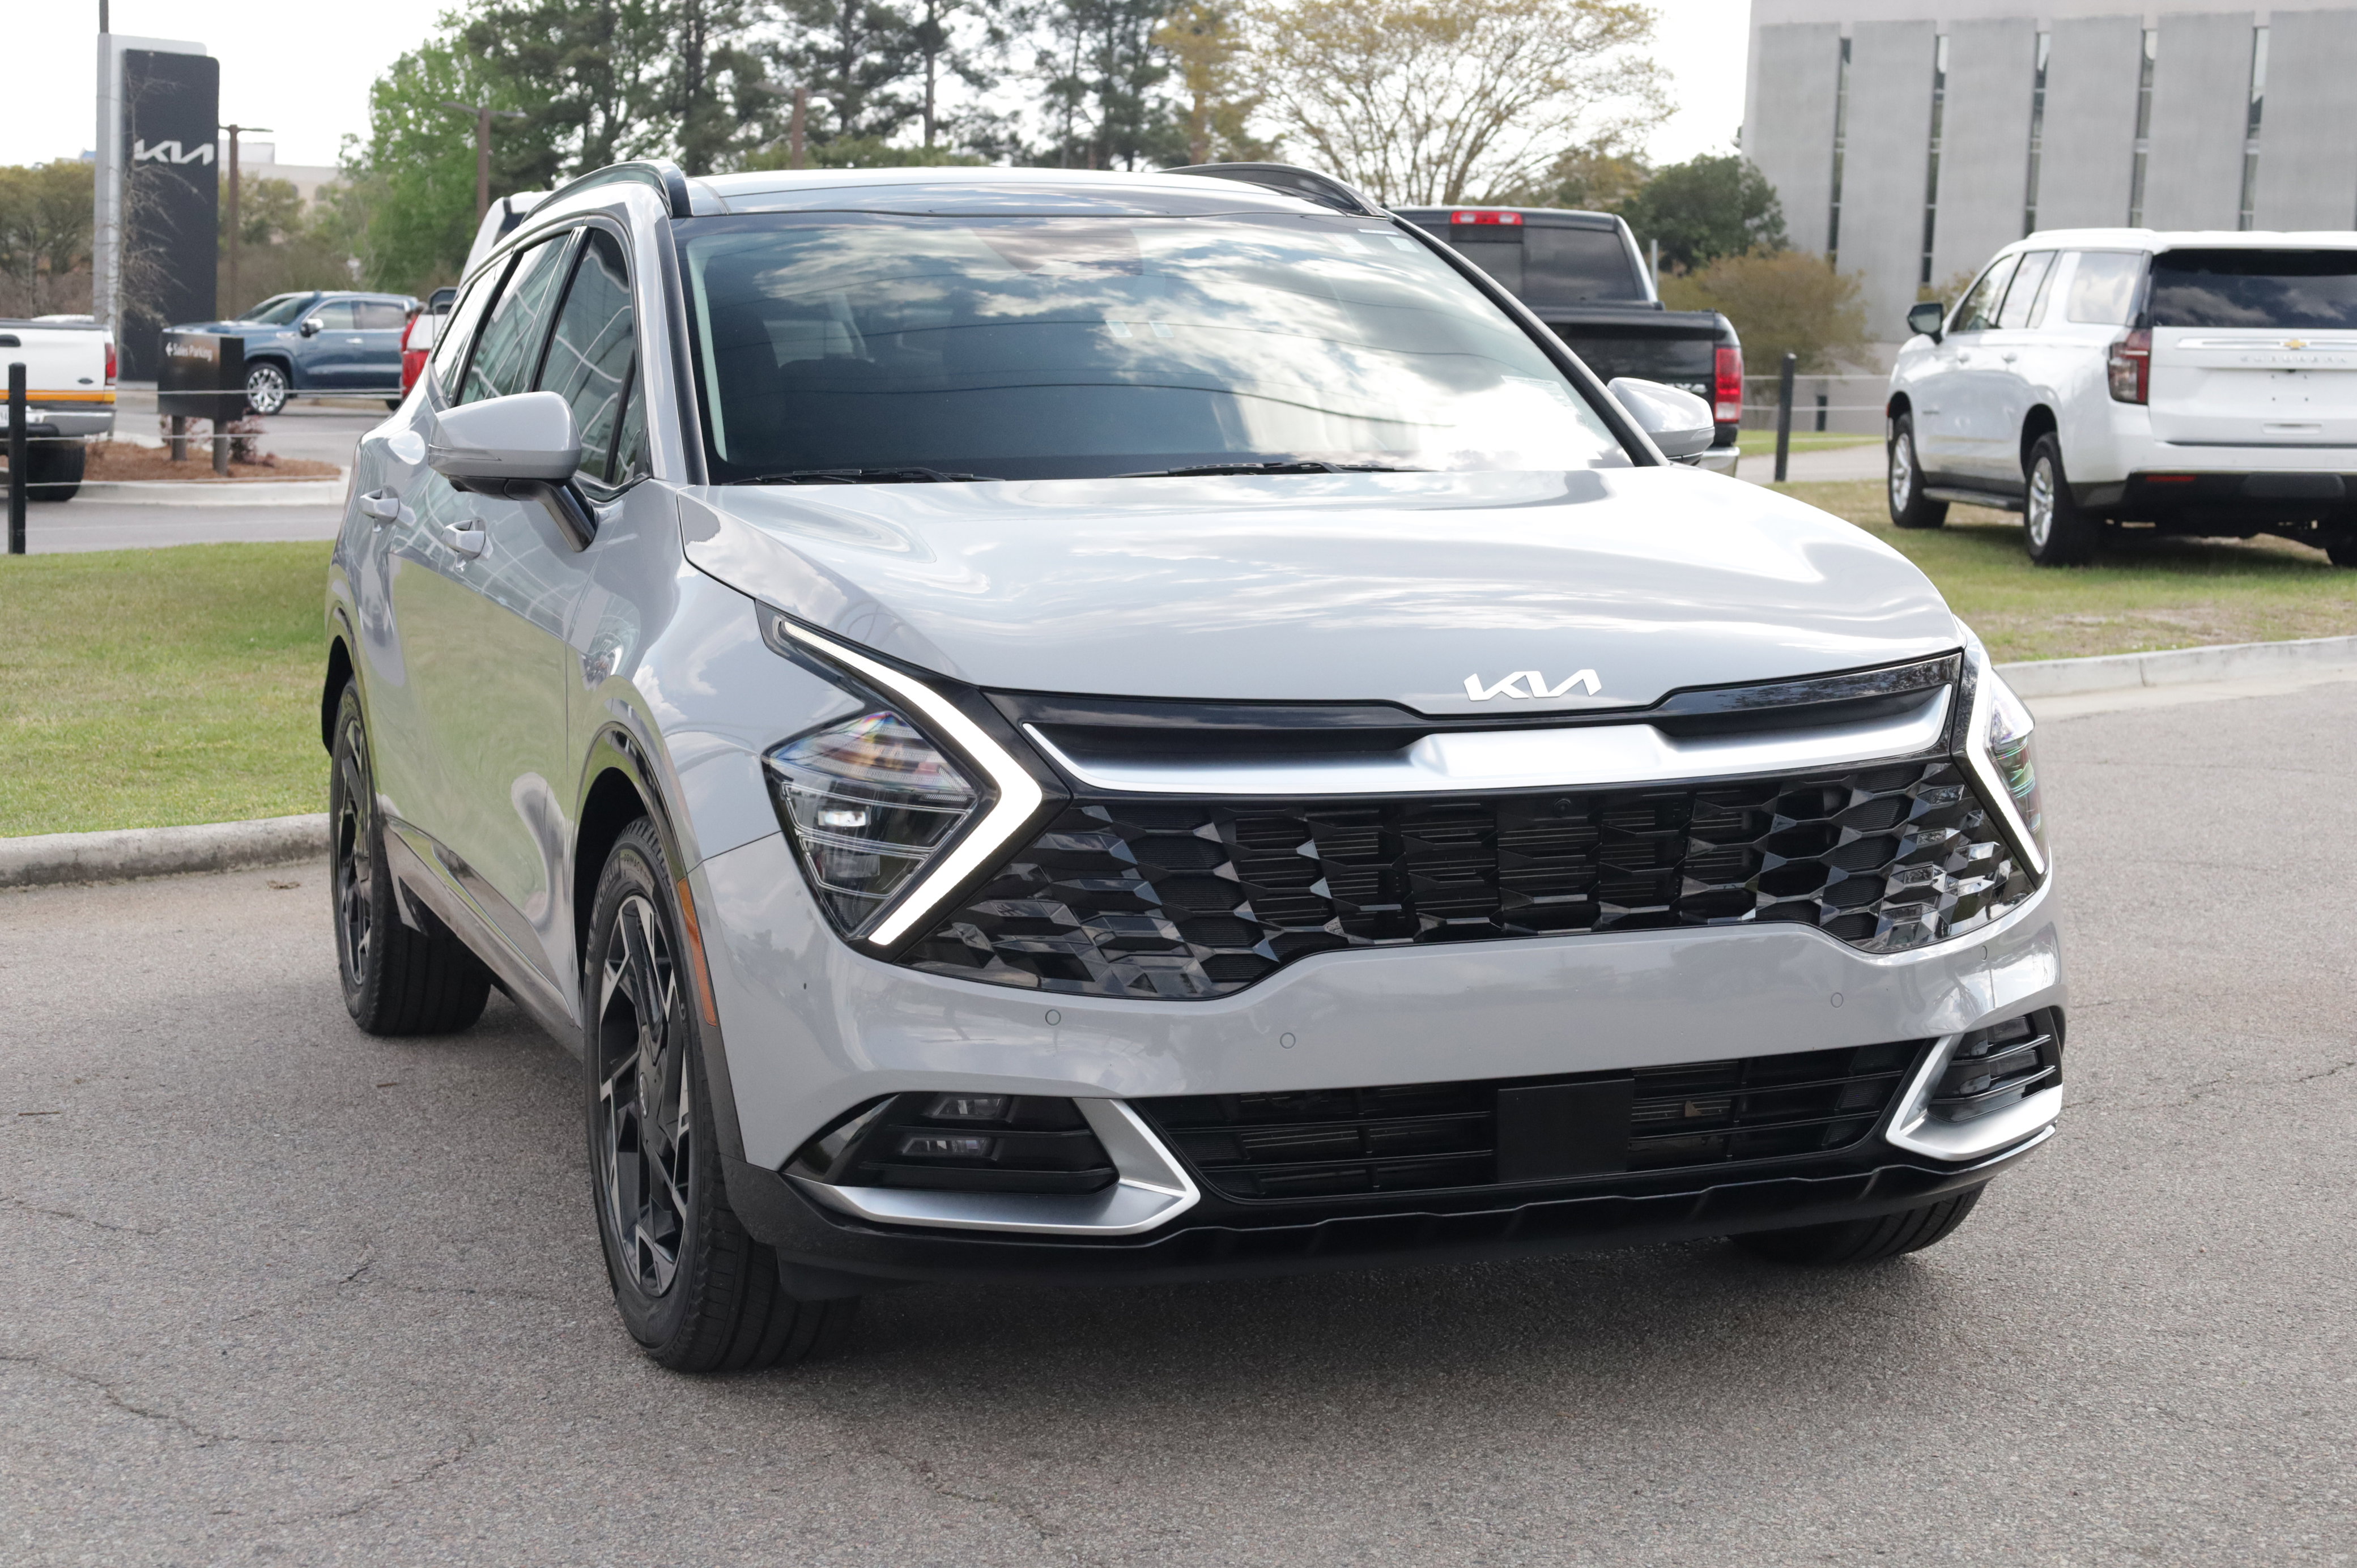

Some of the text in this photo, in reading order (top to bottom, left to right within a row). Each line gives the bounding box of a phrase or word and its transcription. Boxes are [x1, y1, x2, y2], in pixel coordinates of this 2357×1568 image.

[134, 139, 214, 166] KIA
[172, 343, 213, 362] Sales Parking
[1463, 669, 1602, 702] KIA
[592, 856, 620, 928] MICHELIN
